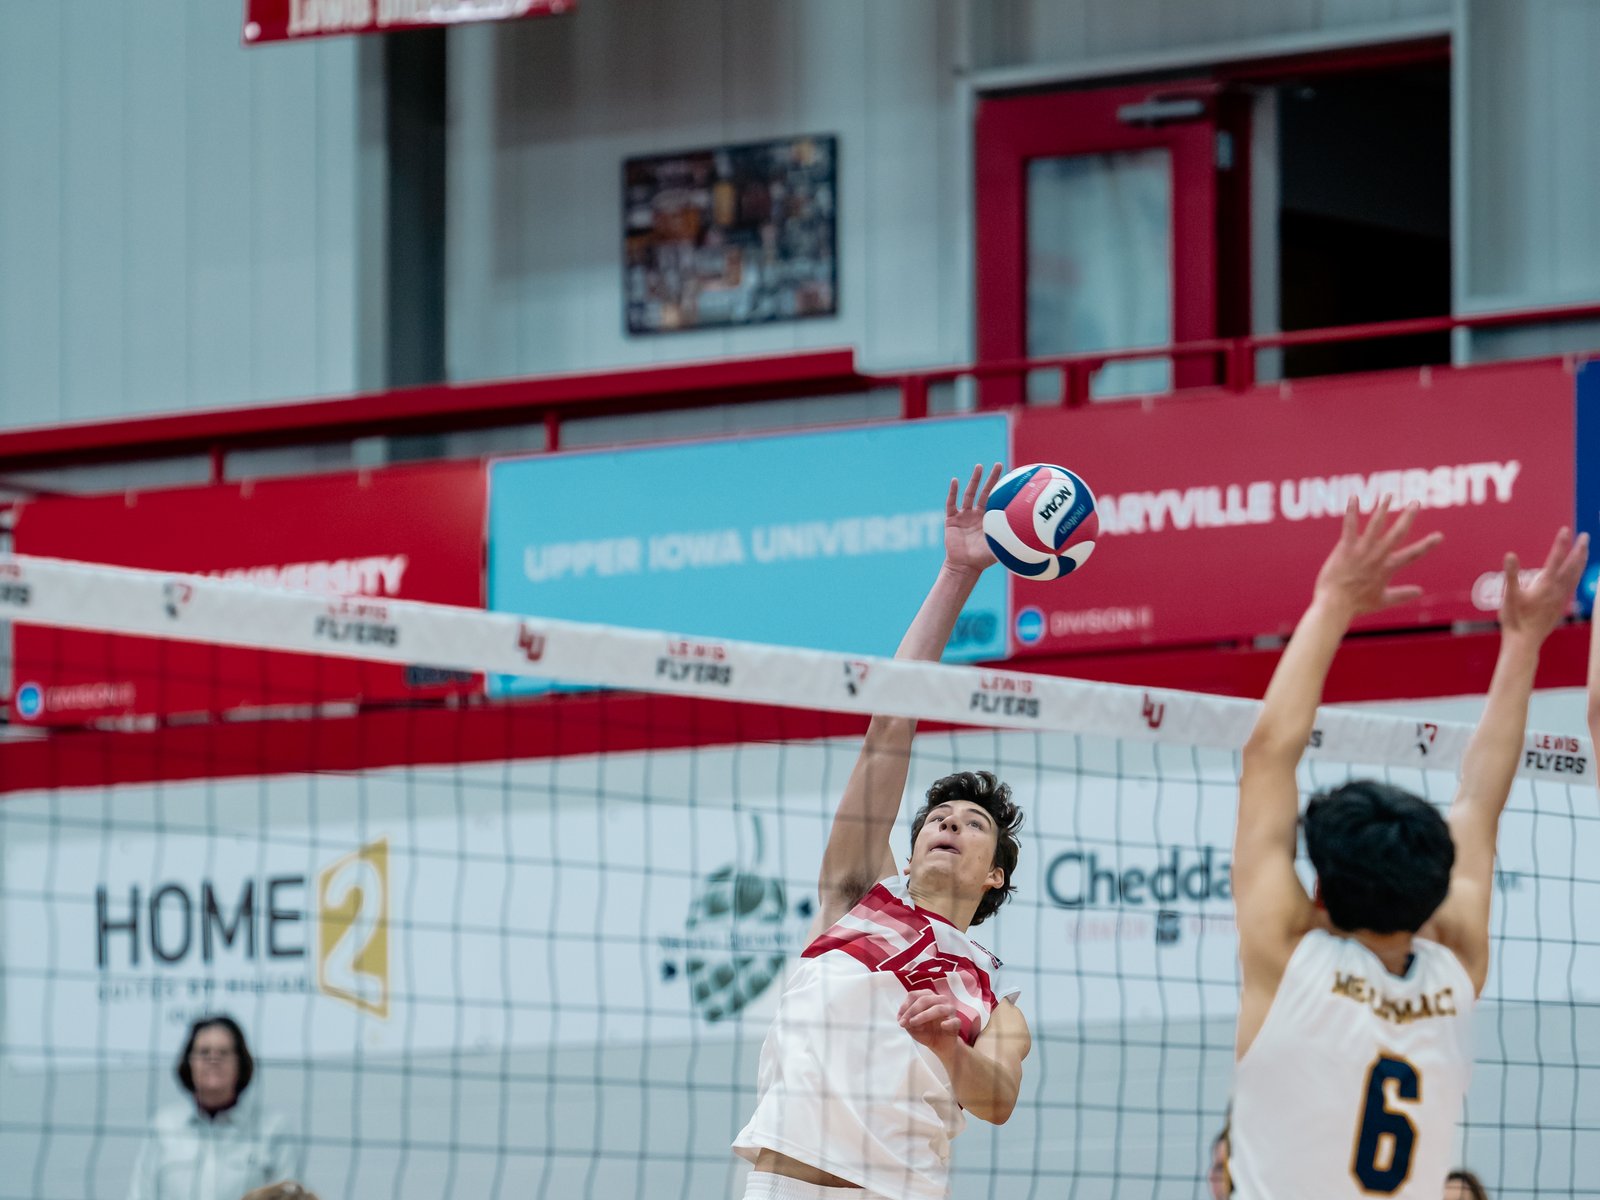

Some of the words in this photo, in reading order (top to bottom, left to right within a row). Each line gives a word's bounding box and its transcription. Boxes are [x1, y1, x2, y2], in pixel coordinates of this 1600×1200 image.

[1039, 486, 1072, 521] NCAA
[1098, 481, 1274, 537] ARYVILLE
[1280, 460, 1520, 520] UNIVERSITY
[524, 537, 640, 582] UPPER
[648, 528, 743, 573] IOWA
[752, 510, 946, 564] UNIVERSIT
[656, 656, 735, 687] FLYERS
[970, 692, 1040, 719] FLYERS
[1526, 751, 1587, 775] FLYERS
[1535, 733, 1579, 753] LEWIS
[1045, 845, 1234, 906] Chedda
[96, 876, 305, 967] HOME
[1350, 1051, 1422, 1196] 6
